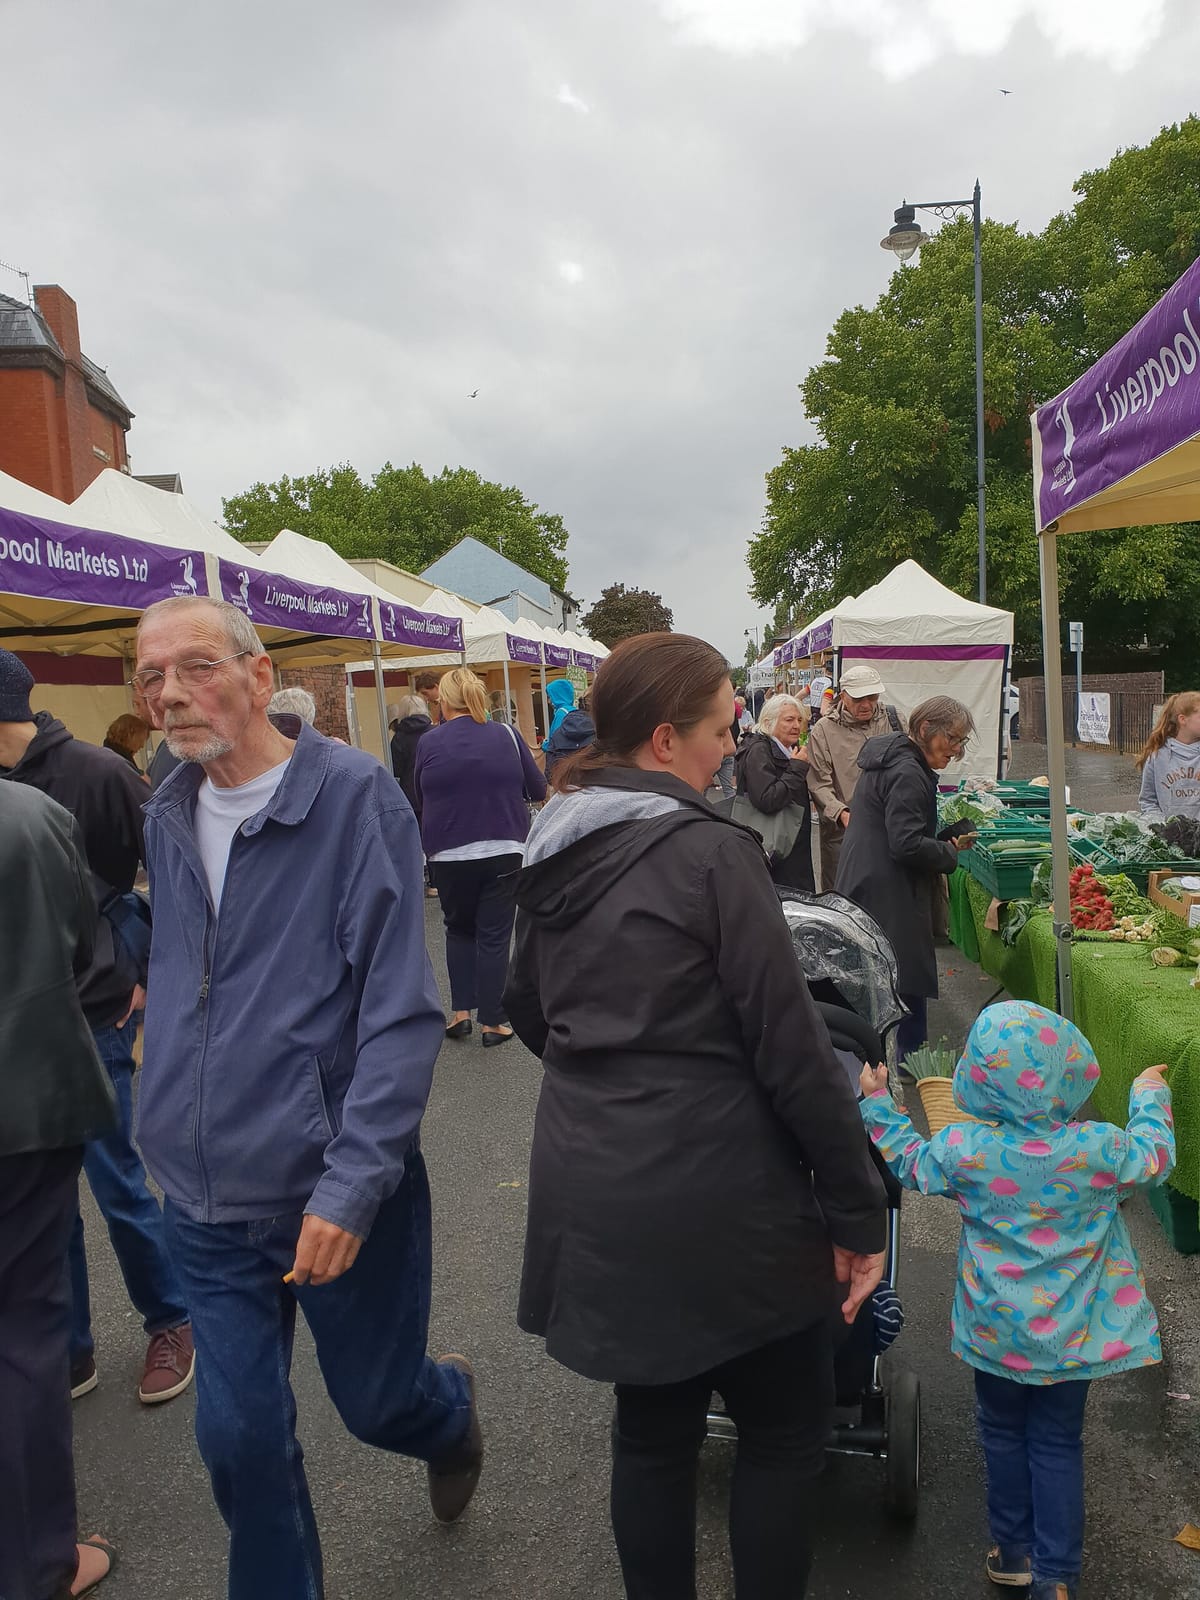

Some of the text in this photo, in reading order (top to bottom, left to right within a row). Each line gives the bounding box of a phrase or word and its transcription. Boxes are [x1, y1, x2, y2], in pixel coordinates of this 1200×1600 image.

[1095, 308, 1200, 436] Liverpool
[46, 540, 120, 578] Markets
[121, 555, 149, 582] Ltd
[264, 585, 307, 614] Liverpool
[307, 595, 338, 616] Markets
[337, 600, 349, 618] Ltd
[402, 615, 425, 635] Liverpool
